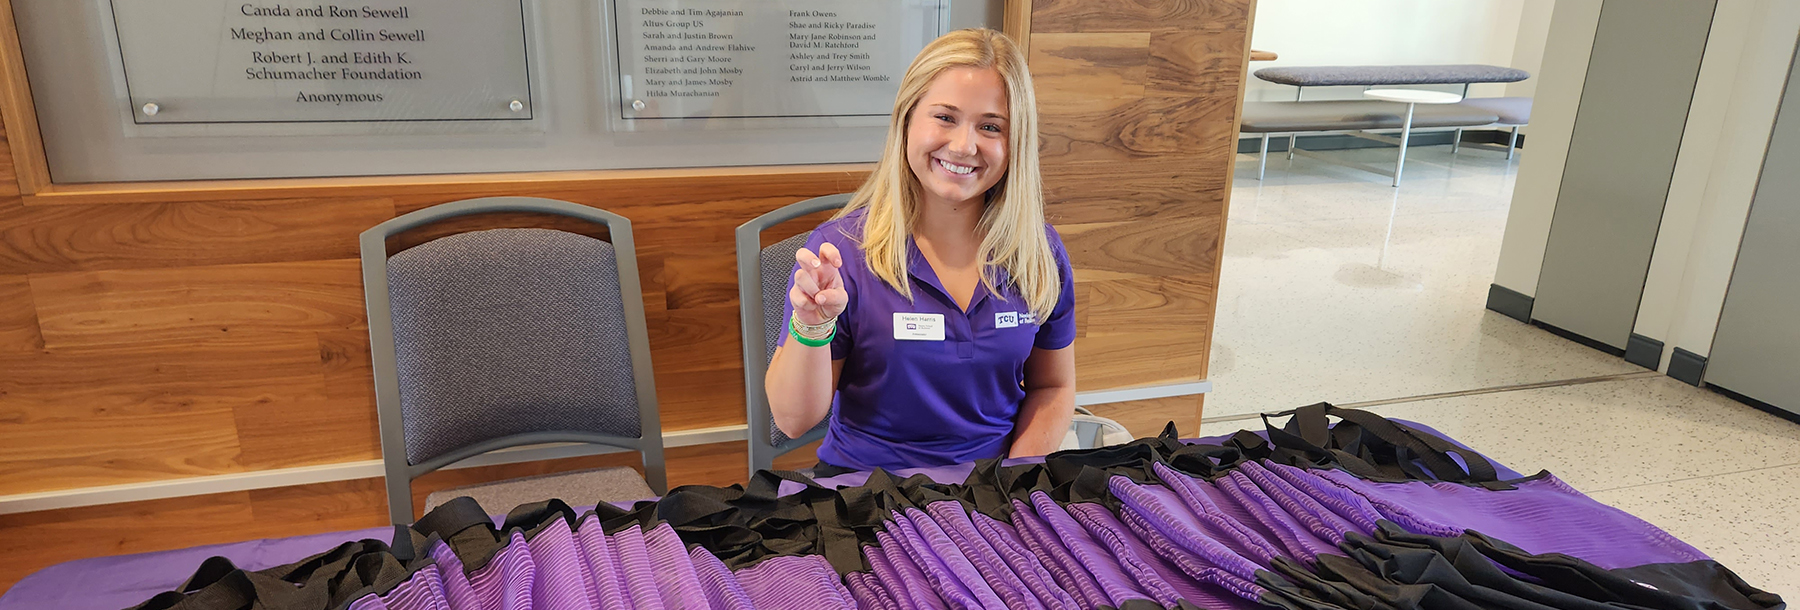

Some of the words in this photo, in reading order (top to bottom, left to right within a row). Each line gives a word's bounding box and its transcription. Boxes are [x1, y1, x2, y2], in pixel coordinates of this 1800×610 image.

[241, 3, 290, 17] Canda
[296, 5, 323, 18] and
[329, 6, 358, 18] Ron
[362, 6, 409, 19] Sewell
[641, 7, 669, 16] Debbie
[671, 8, 685, 16] and
[687, 8, 703, 16] Tim
[705, 9, 744, 18] Agajanian
[665, 20, 690, 29] Group
[692, 20, 704, 28] US
[789, 21, 806, 29] Shae
[824, 22, 844, 30] Ricky
[230, 27, 292, 43] Meghan
[298, 28, 325, 41] and
[330, 29, 375, 41] Collin
[379, 29, 425, 42] Sewell
[683, 32, 706, 40] Justin
[708, 32, 733, 40] Brown
[789, 33, 809, 42] Mary
[811, 33, 826, 41] Jane
[728, 44, 755, 52] Flahive
[789, 41, 811, 49] David
[252, 51, 302, 64] Robert
[307, 52, 316, 65] J.
[321, 52, 348, 64] and
[354, 51, 392, 64] Edith
[397, 52, 412, 64] K.
[686, 56, 705, 64] Gary
[790, 53, 814, 61] Ashley
[832, 53, 847, 61] Trey
[699, 67, 717, 75] John
[719, 67, 743, 76] Mosby
[790, 64, 809, 72] Caryl
[827, 64, 844, 72] Jerry
[246, 67, 337, 80] Schumacher
[342, 68, 422, 80] Foundation
[645, 79, 666, 87] Mary
[708, 79, 733, 87] Mosby
[296, 91, 383, 105] Anonymous
[998, 315, 1015, 324] TCU
